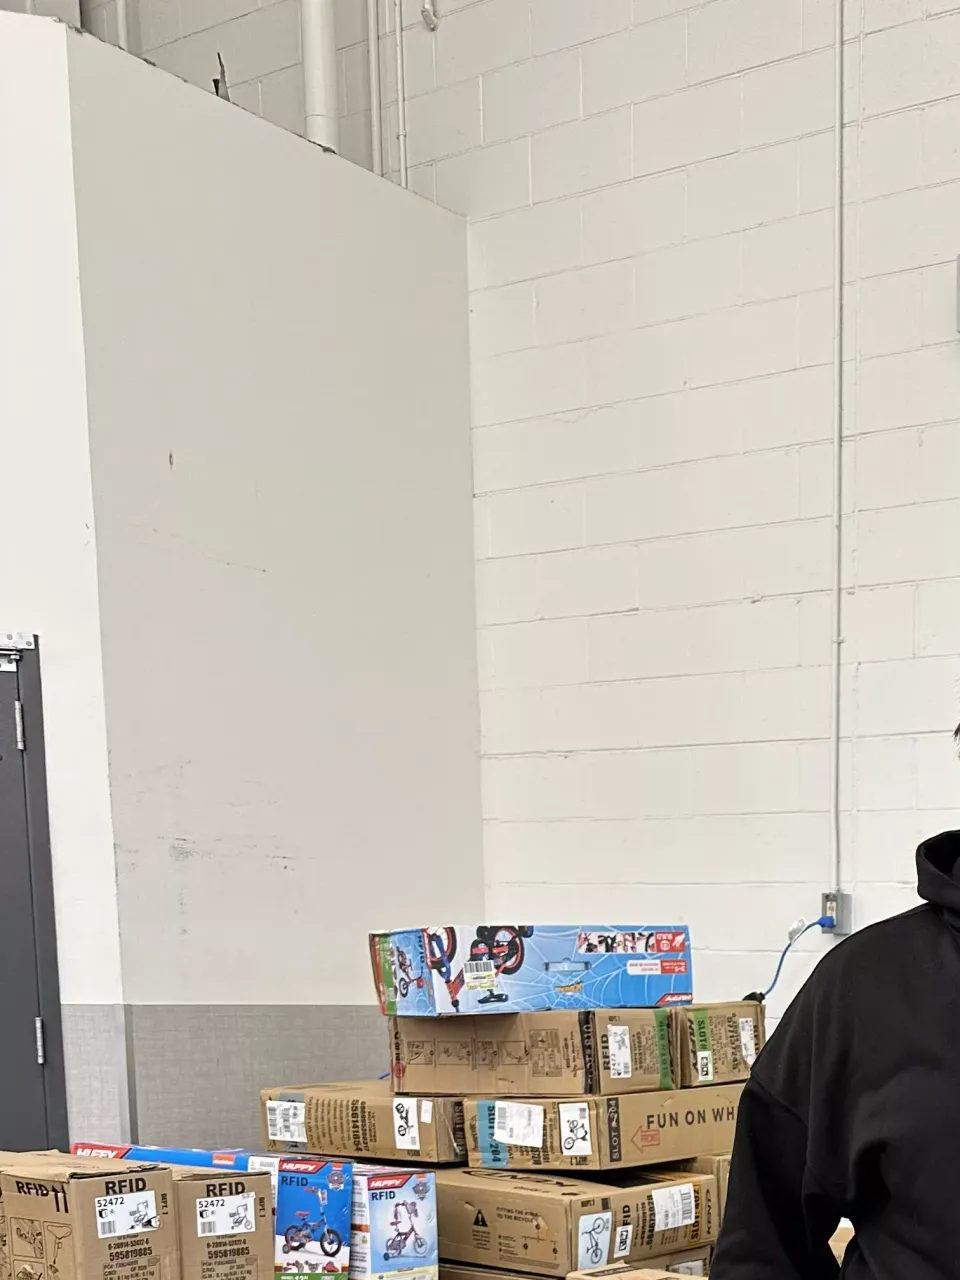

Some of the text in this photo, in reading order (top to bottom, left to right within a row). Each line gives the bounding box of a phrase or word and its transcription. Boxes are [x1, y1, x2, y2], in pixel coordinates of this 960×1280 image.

[698, 1020, 709, 1051] SLOT#
[647, 1106, 735, 1129] FUN ON WH
[490, 1143, 502, 1163] 204
[612, 1131, 620, 1160] SLOT
[282, 1163, 317, 1171] HUFFY
[15, 1180, 50, 1197] RFID
[104, 1177, 147, 1196] RFID
[206, 1181, 246, 1198] RFID
[281, 1176, 309, 1187] RFID
[369, 1178, 403, 1188] HUFFY
[97, 1196, 125, 1208] 52472
[198, 1199, 226, 1209] 52472
[371, 1190, 396, 1202] RFID
[622, 1204, 631, 1226] FID
